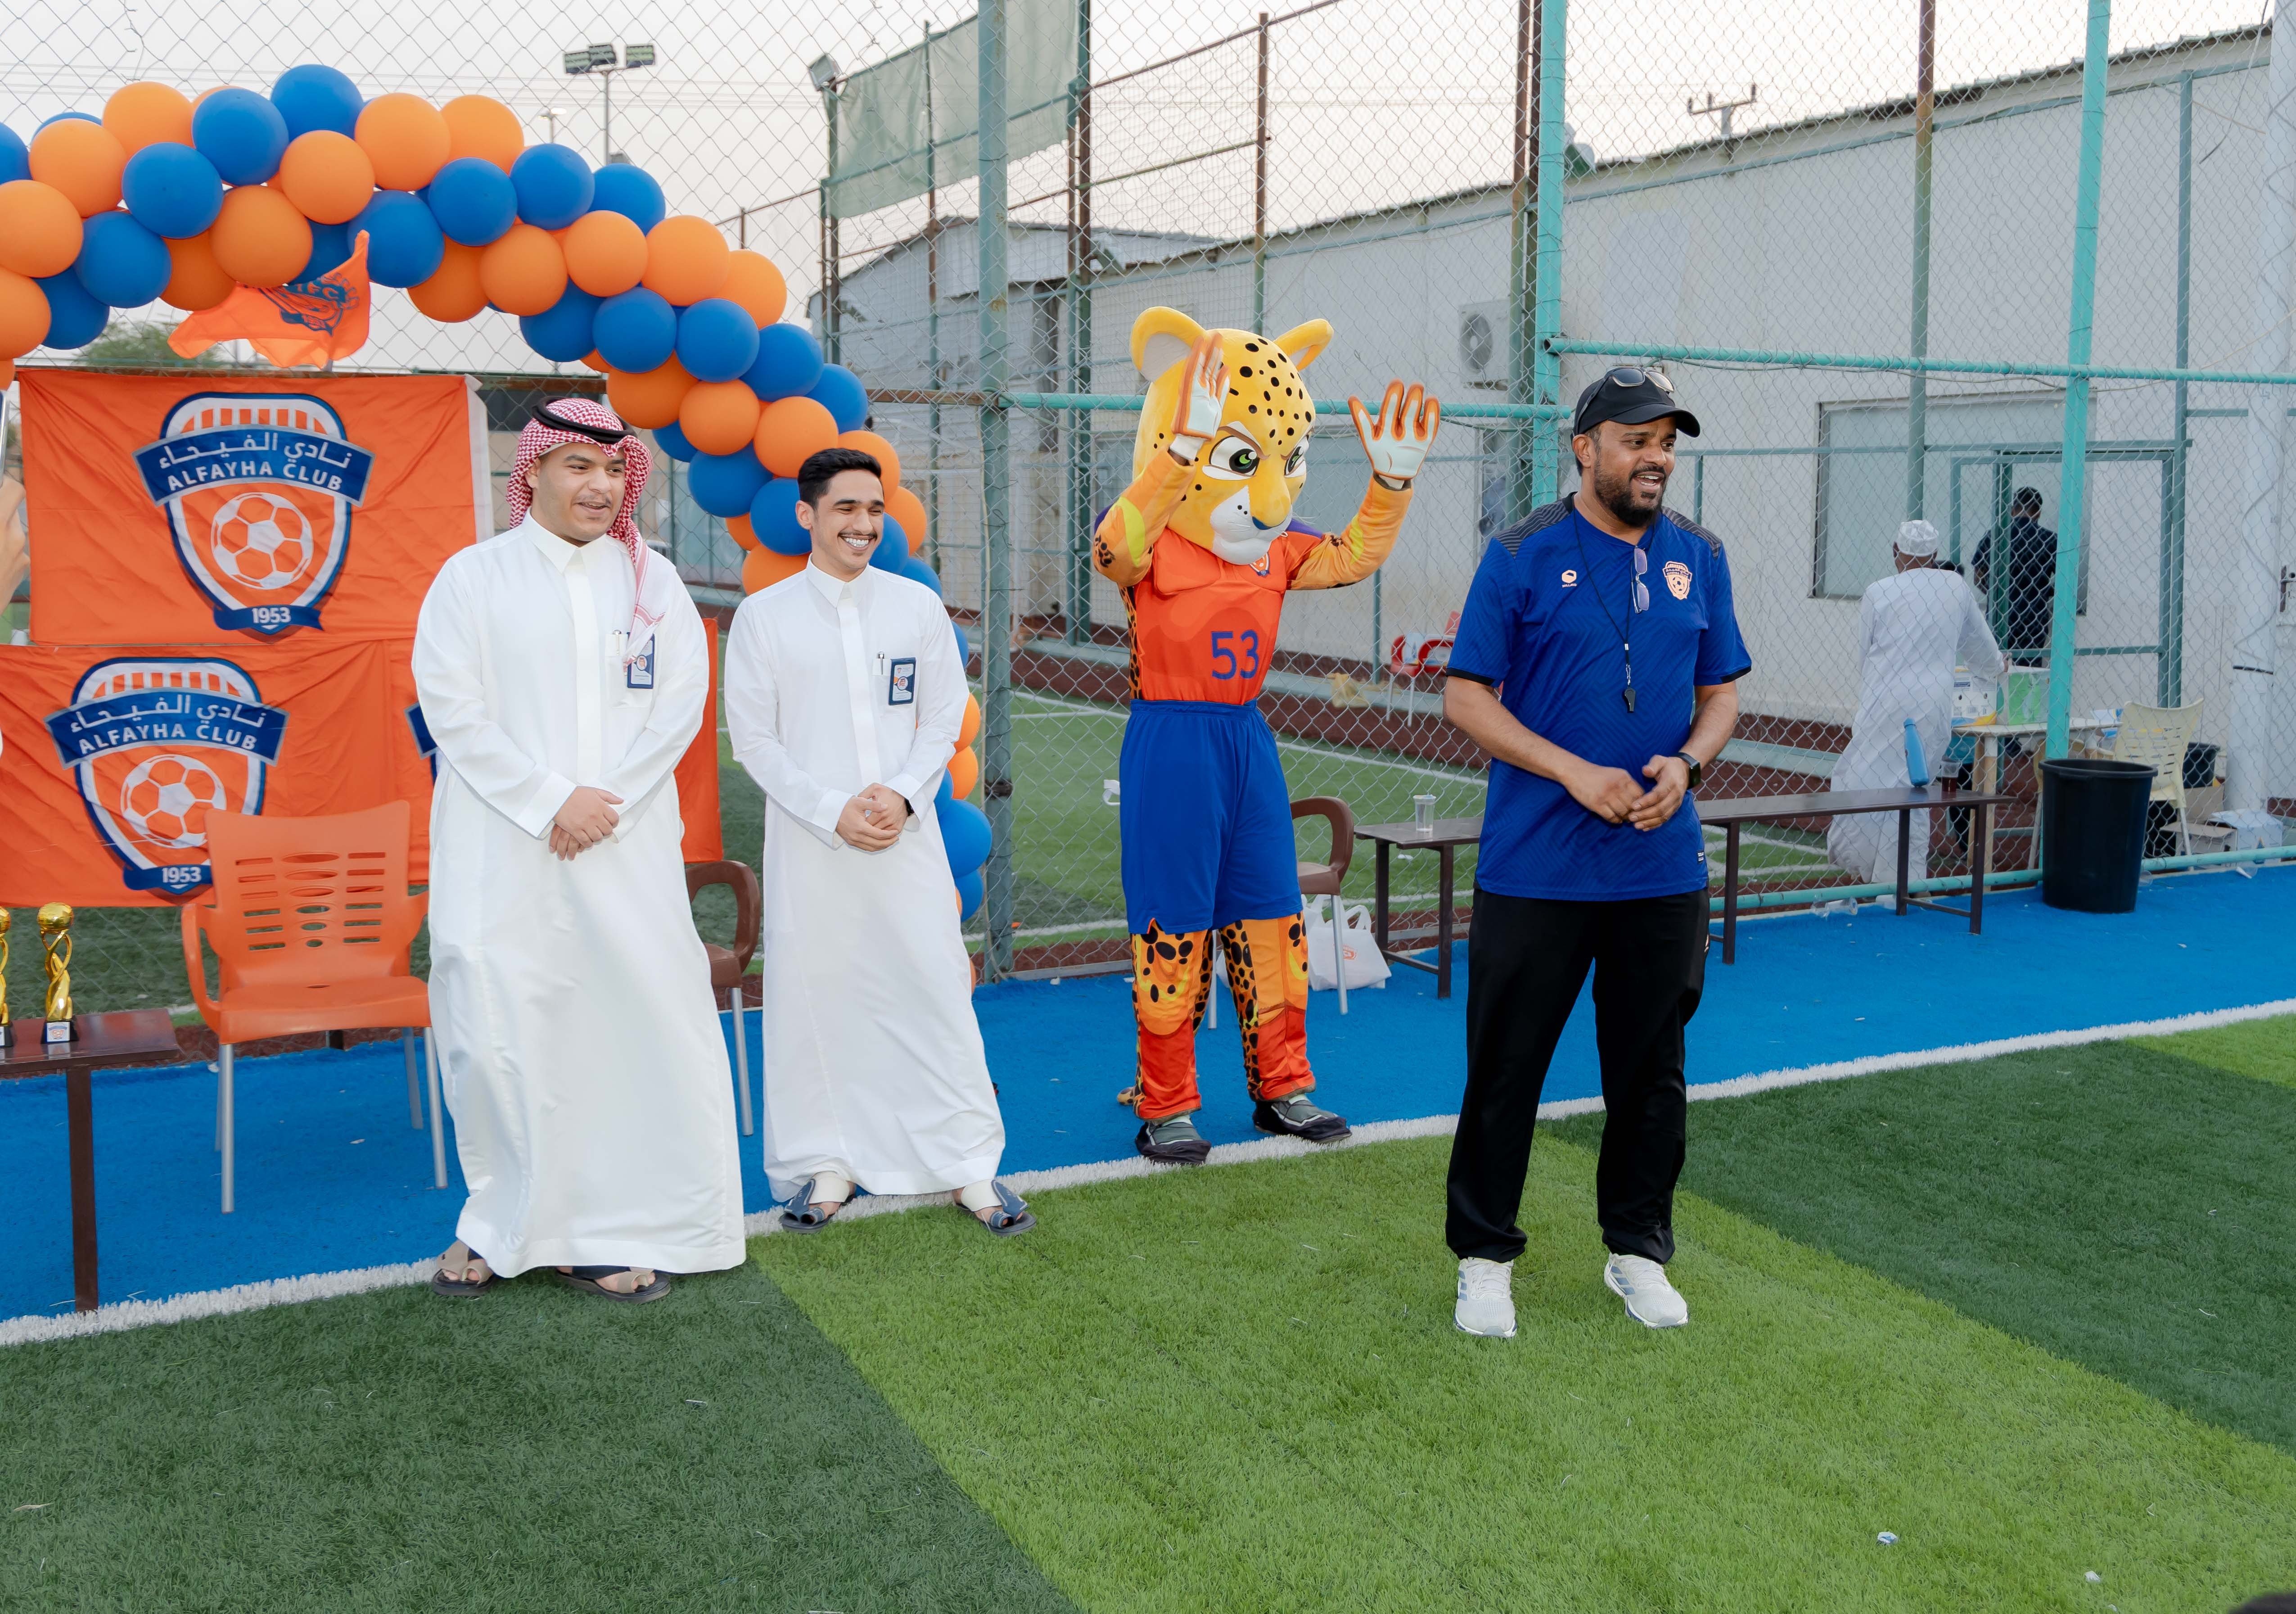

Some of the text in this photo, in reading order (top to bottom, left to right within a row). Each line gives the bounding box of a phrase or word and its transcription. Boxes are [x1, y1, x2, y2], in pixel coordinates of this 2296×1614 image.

[159, 432, 352, 469] نادي الفيحاء
[167, 461, 343, 491] ALFAYHA CLUB
[251, 607, 291, 624] 1953
[1211, 629, 1259, 680] 53
[71, 694, 266, 732] نادي الفيحاء
[79, 723, 257, 754] ALFAYHA CLUB
[162, 867, 202, 883] 1953
